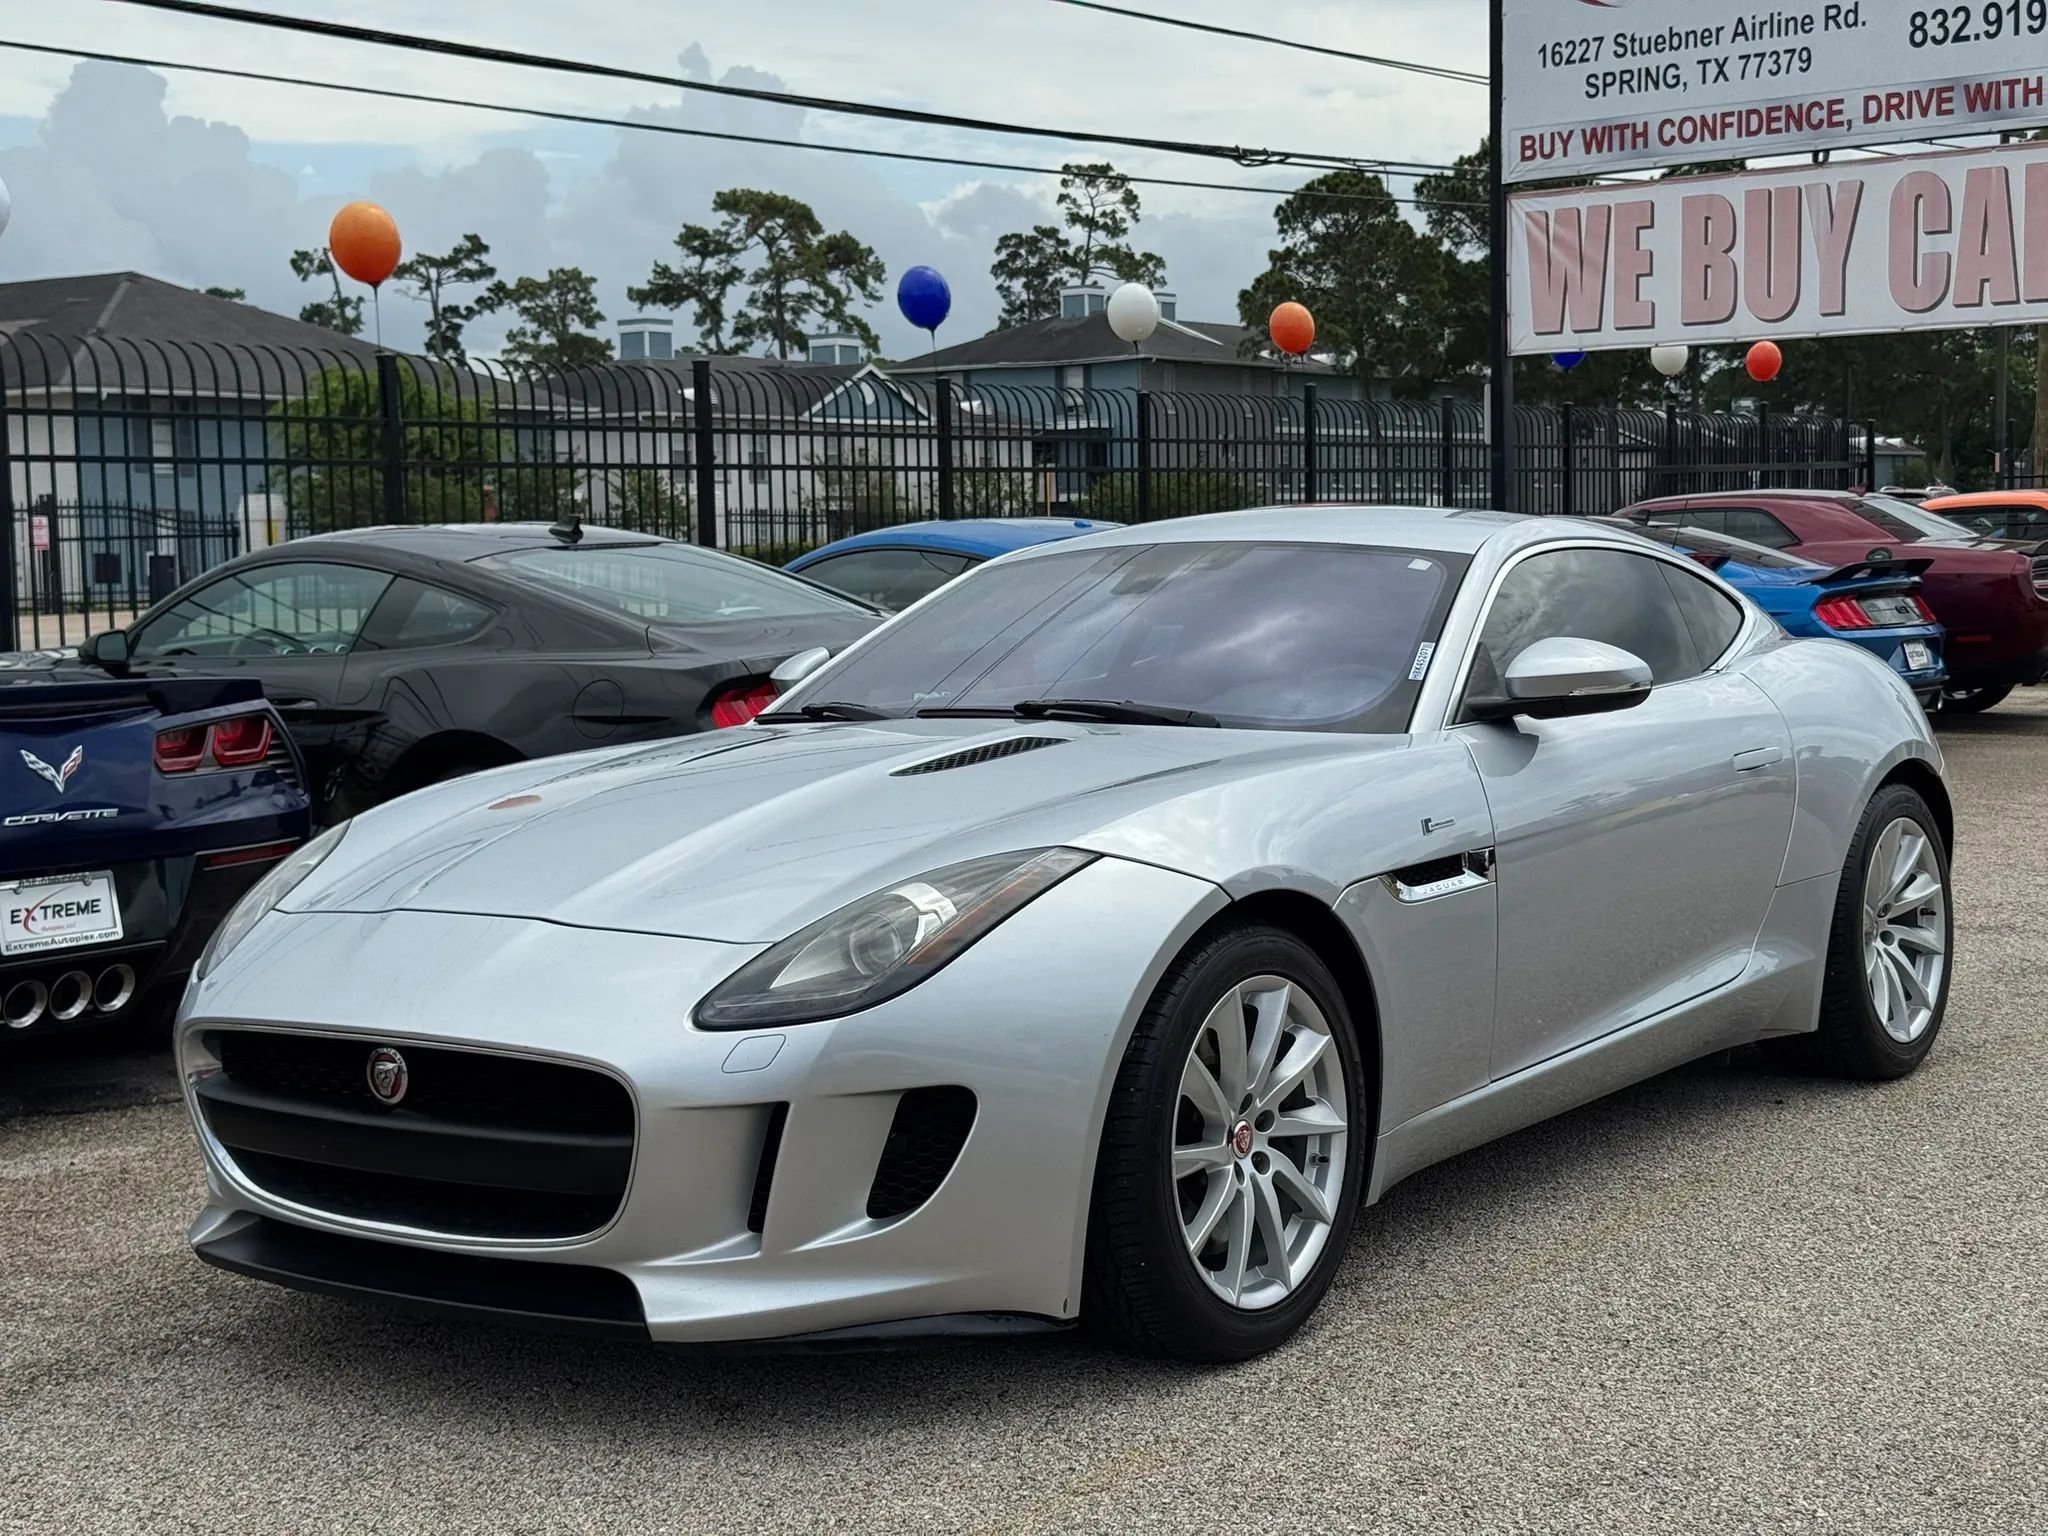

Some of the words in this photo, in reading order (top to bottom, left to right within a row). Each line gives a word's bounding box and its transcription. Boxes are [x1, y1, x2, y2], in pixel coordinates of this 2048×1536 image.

[1538, 36, 1604, 69] 16227
[1613, 26, 1725, 59] Stuebner
[1731, 11, 1815, 44] Airline
[1824, 1, 1867, 32] Rd.
[1585, 63, 1688, 99] SPRING,
[1696, 56, 1729, 85] TX
[1738, 46, 1812, 80] 77379
[1520, 129, 1575, 162] BUY
[1581, 121, 1648, 155] WITH
[1657, 98, 1853, 147] CONFIDENCE,
[1863, 85, 1954, 125] DRIVE
[1963, 76, 2043, 113] WITH
[1525, 200, 1655, 336] WE
[1681, 180, 1865, 327] BUY
[3, 808, 119, 826] CORVETTE
[10, 899, 102, 925] EXTREME
[1423, 879, 1465, 895] JAGUAR
